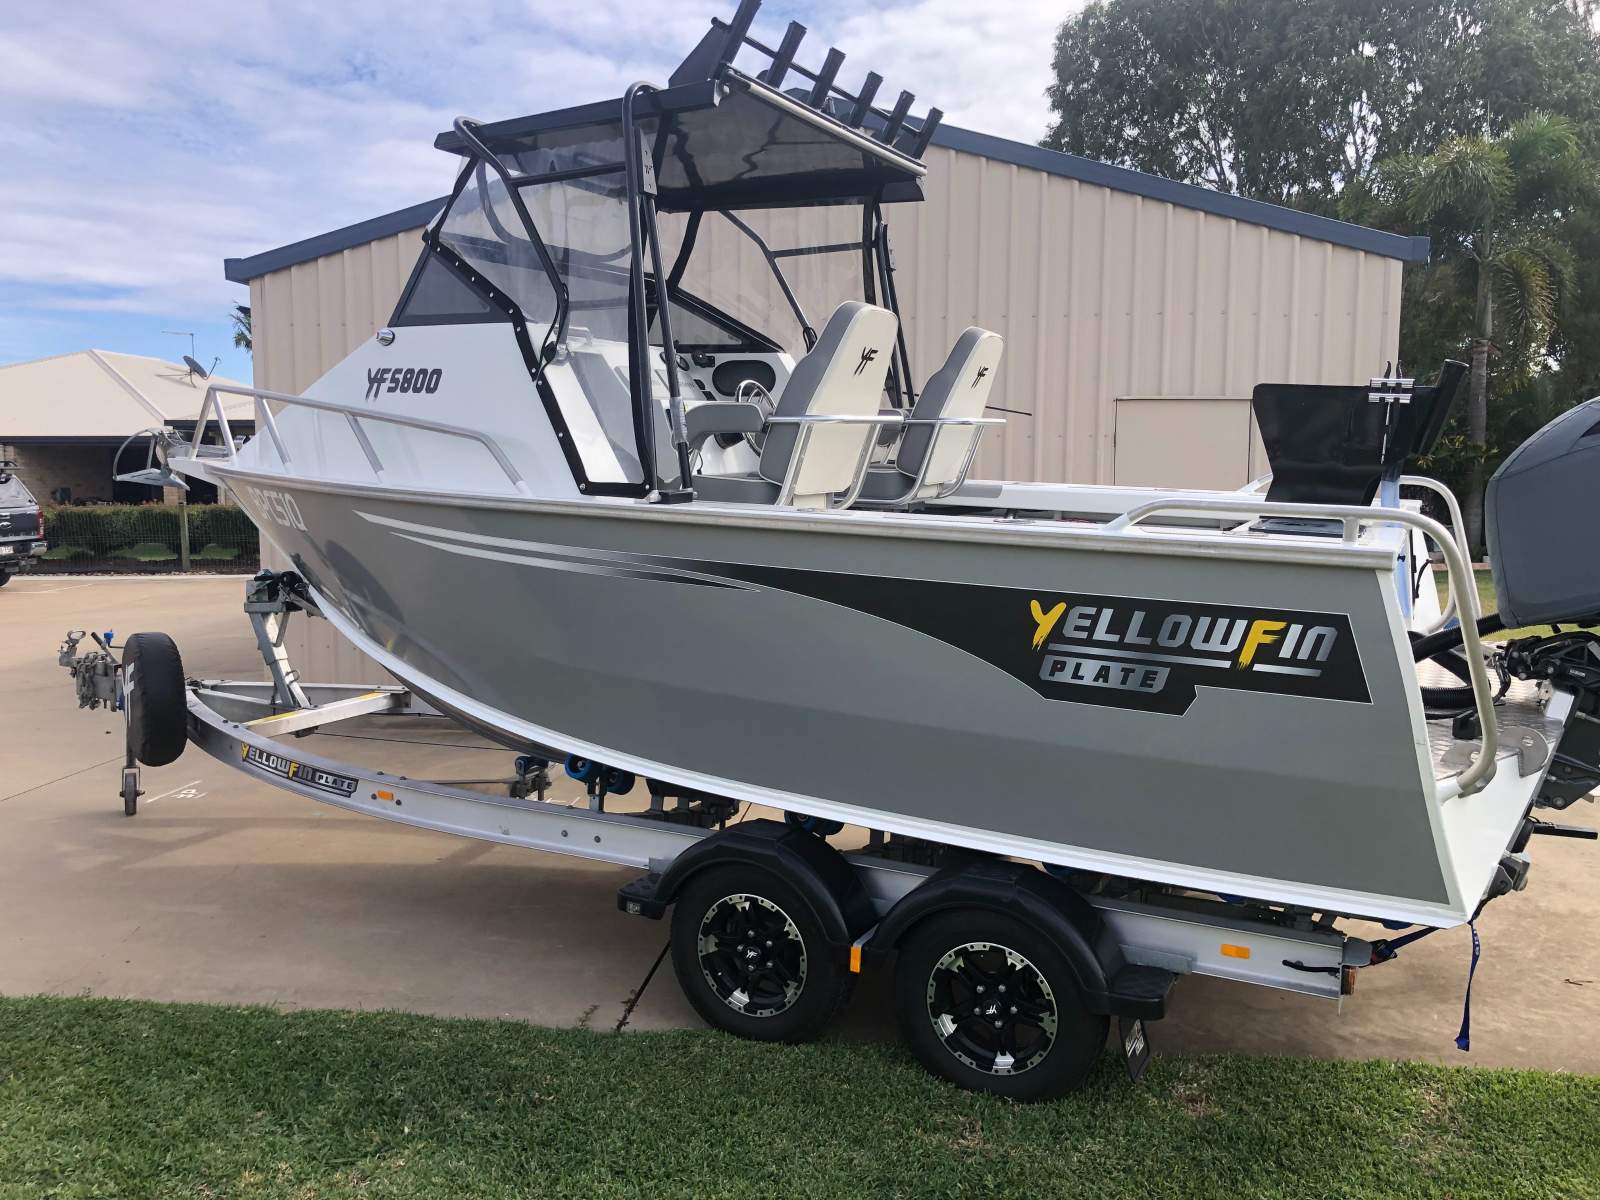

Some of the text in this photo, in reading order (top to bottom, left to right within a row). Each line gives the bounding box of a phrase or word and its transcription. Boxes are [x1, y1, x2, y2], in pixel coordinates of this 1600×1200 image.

[365, 367, 443, 402] YF5800
[1048, 658, 1161, 690] PLATE
[318, 772, 355, 791] PLATE
